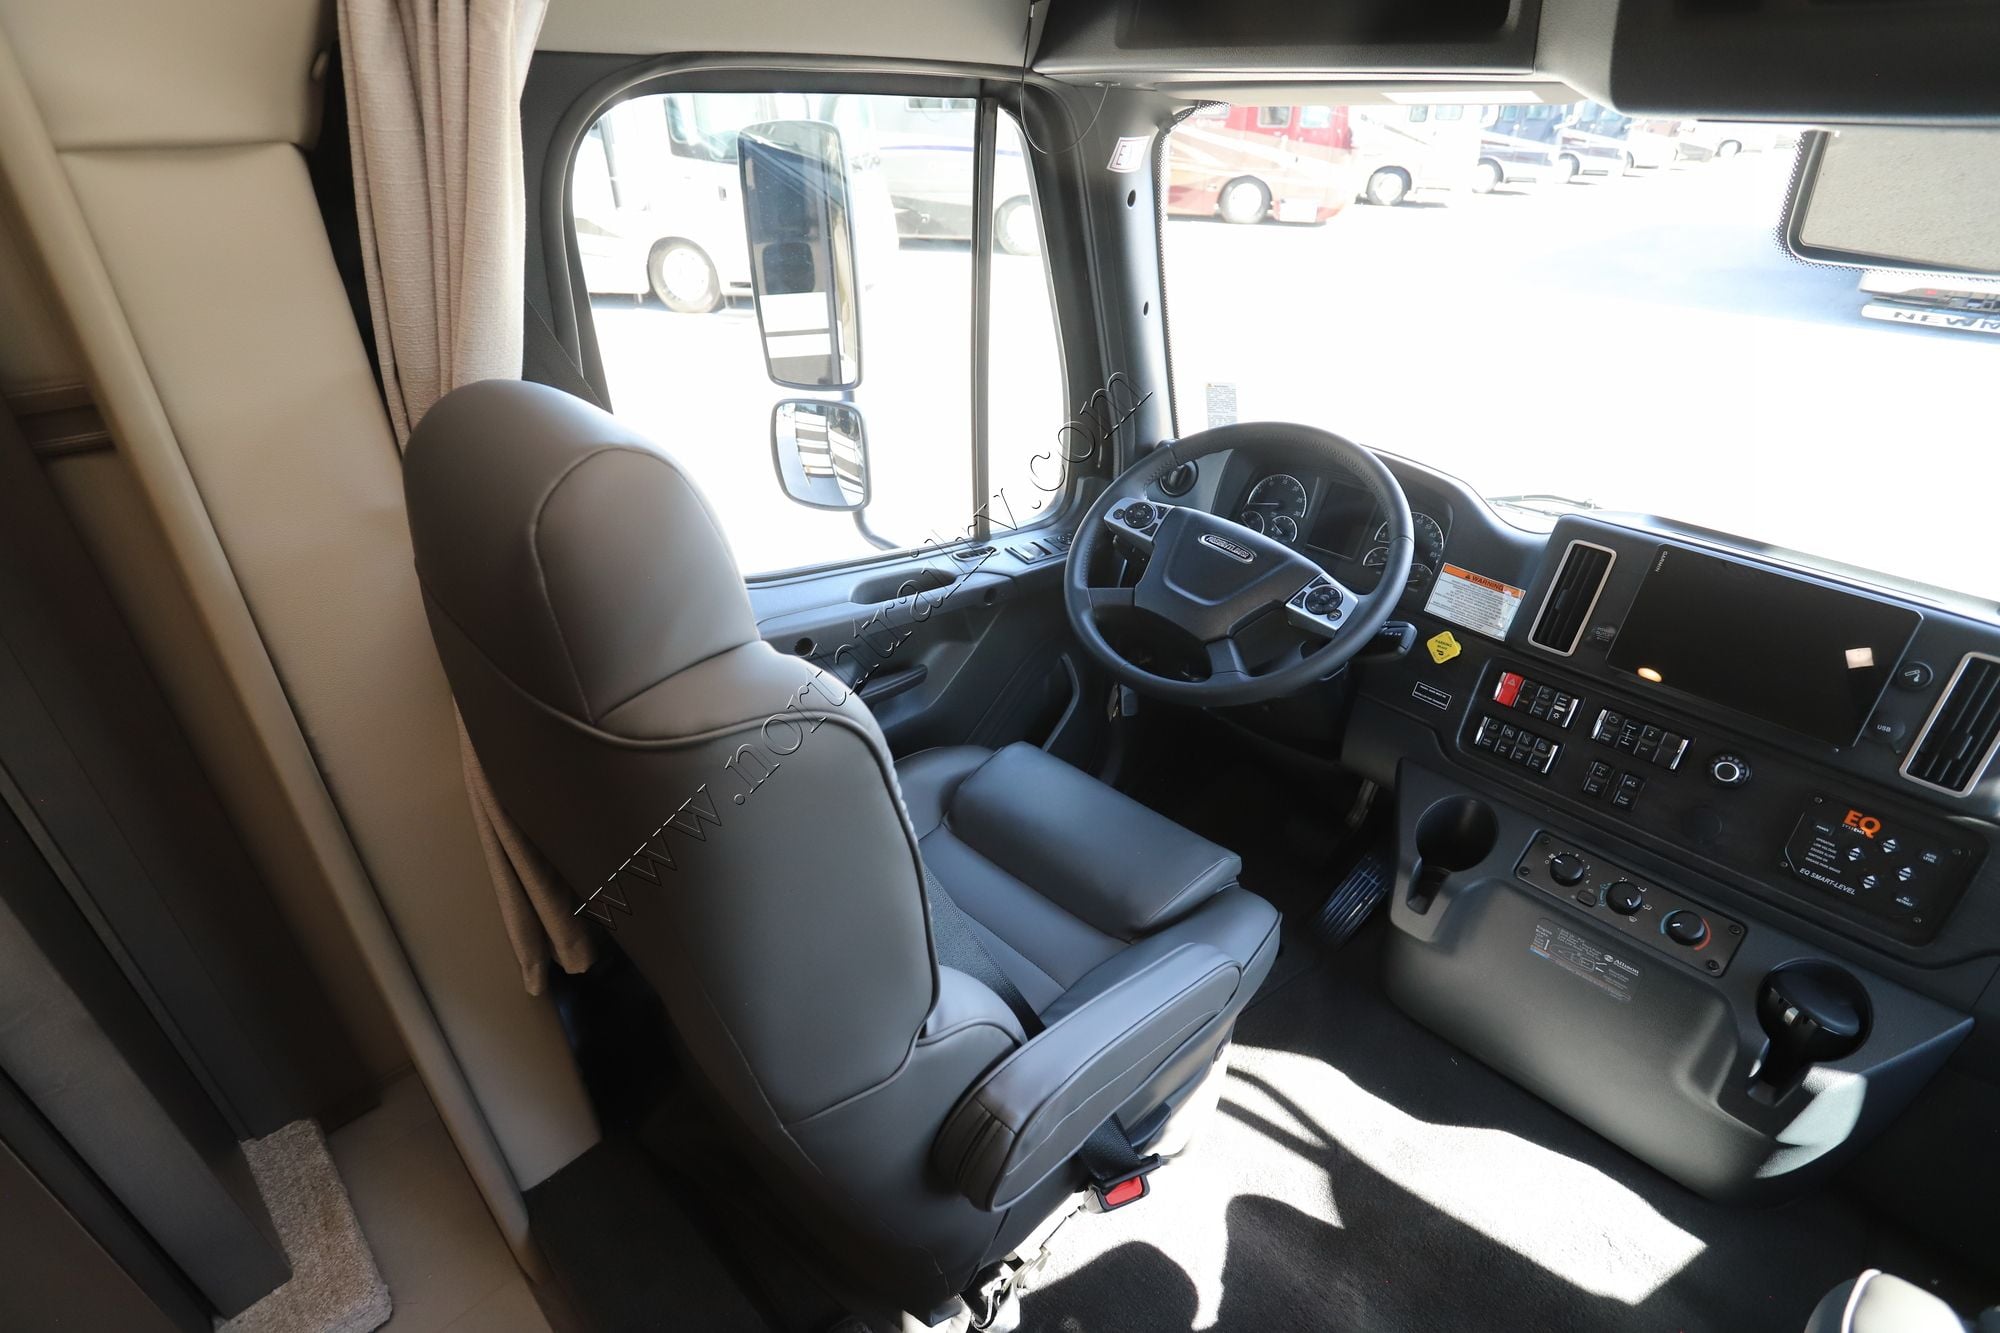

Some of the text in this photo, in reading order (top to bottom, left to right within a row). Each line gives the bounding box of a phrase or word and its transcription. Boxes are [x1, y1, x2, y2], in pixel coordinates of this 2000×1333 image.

[1472, 575, 1504, 592] WARNING
[1876, 723, 1892, 733] USB
[1843, 809, 1882, 839] EQ
[1799, 867, 1856, 895] EQ SMART-LEVEL
[1614, 959, 1639, 974] Allison
